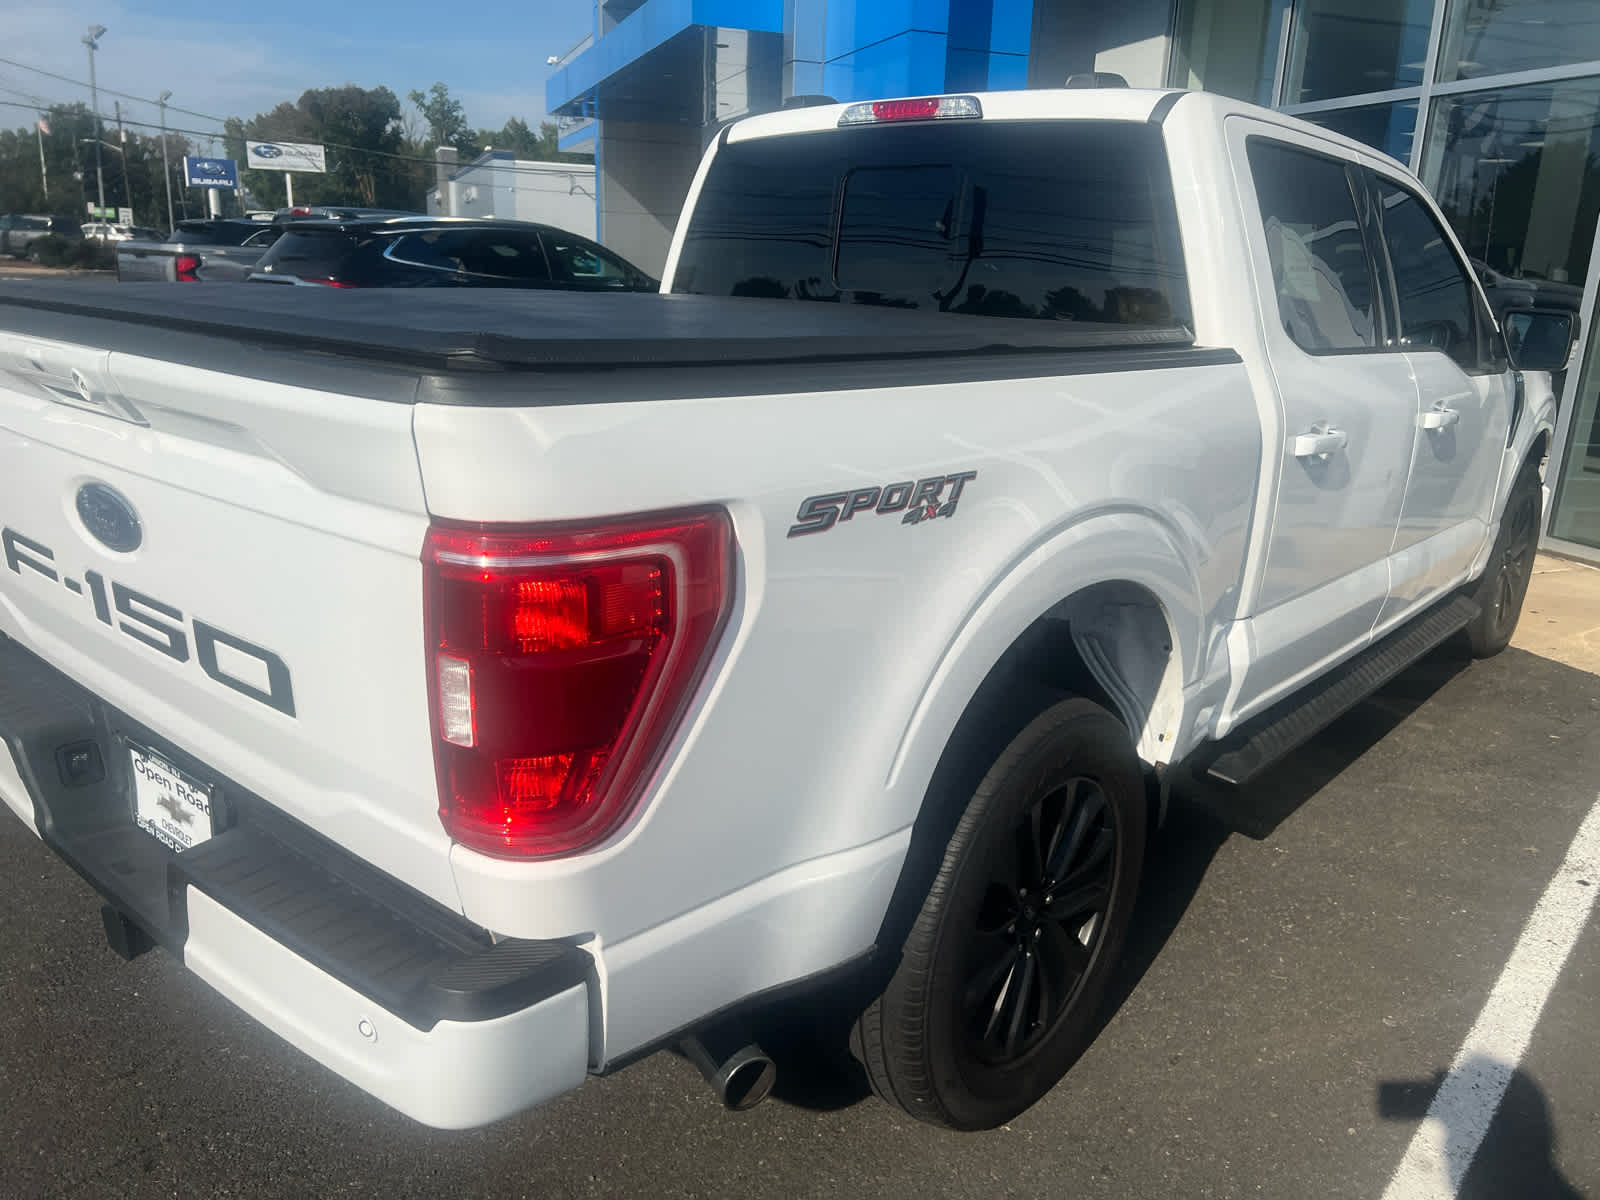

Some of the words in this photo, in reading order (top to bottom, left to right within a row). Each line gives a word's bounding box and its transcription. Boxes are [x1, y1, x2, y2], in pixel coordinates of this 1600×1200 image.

[191, 177, 233, 186] SUBARU
[787, 470, 977, 538] SPORT
[1, 527, 297, 718] F-150
[135, 758, 172, 790] Open
